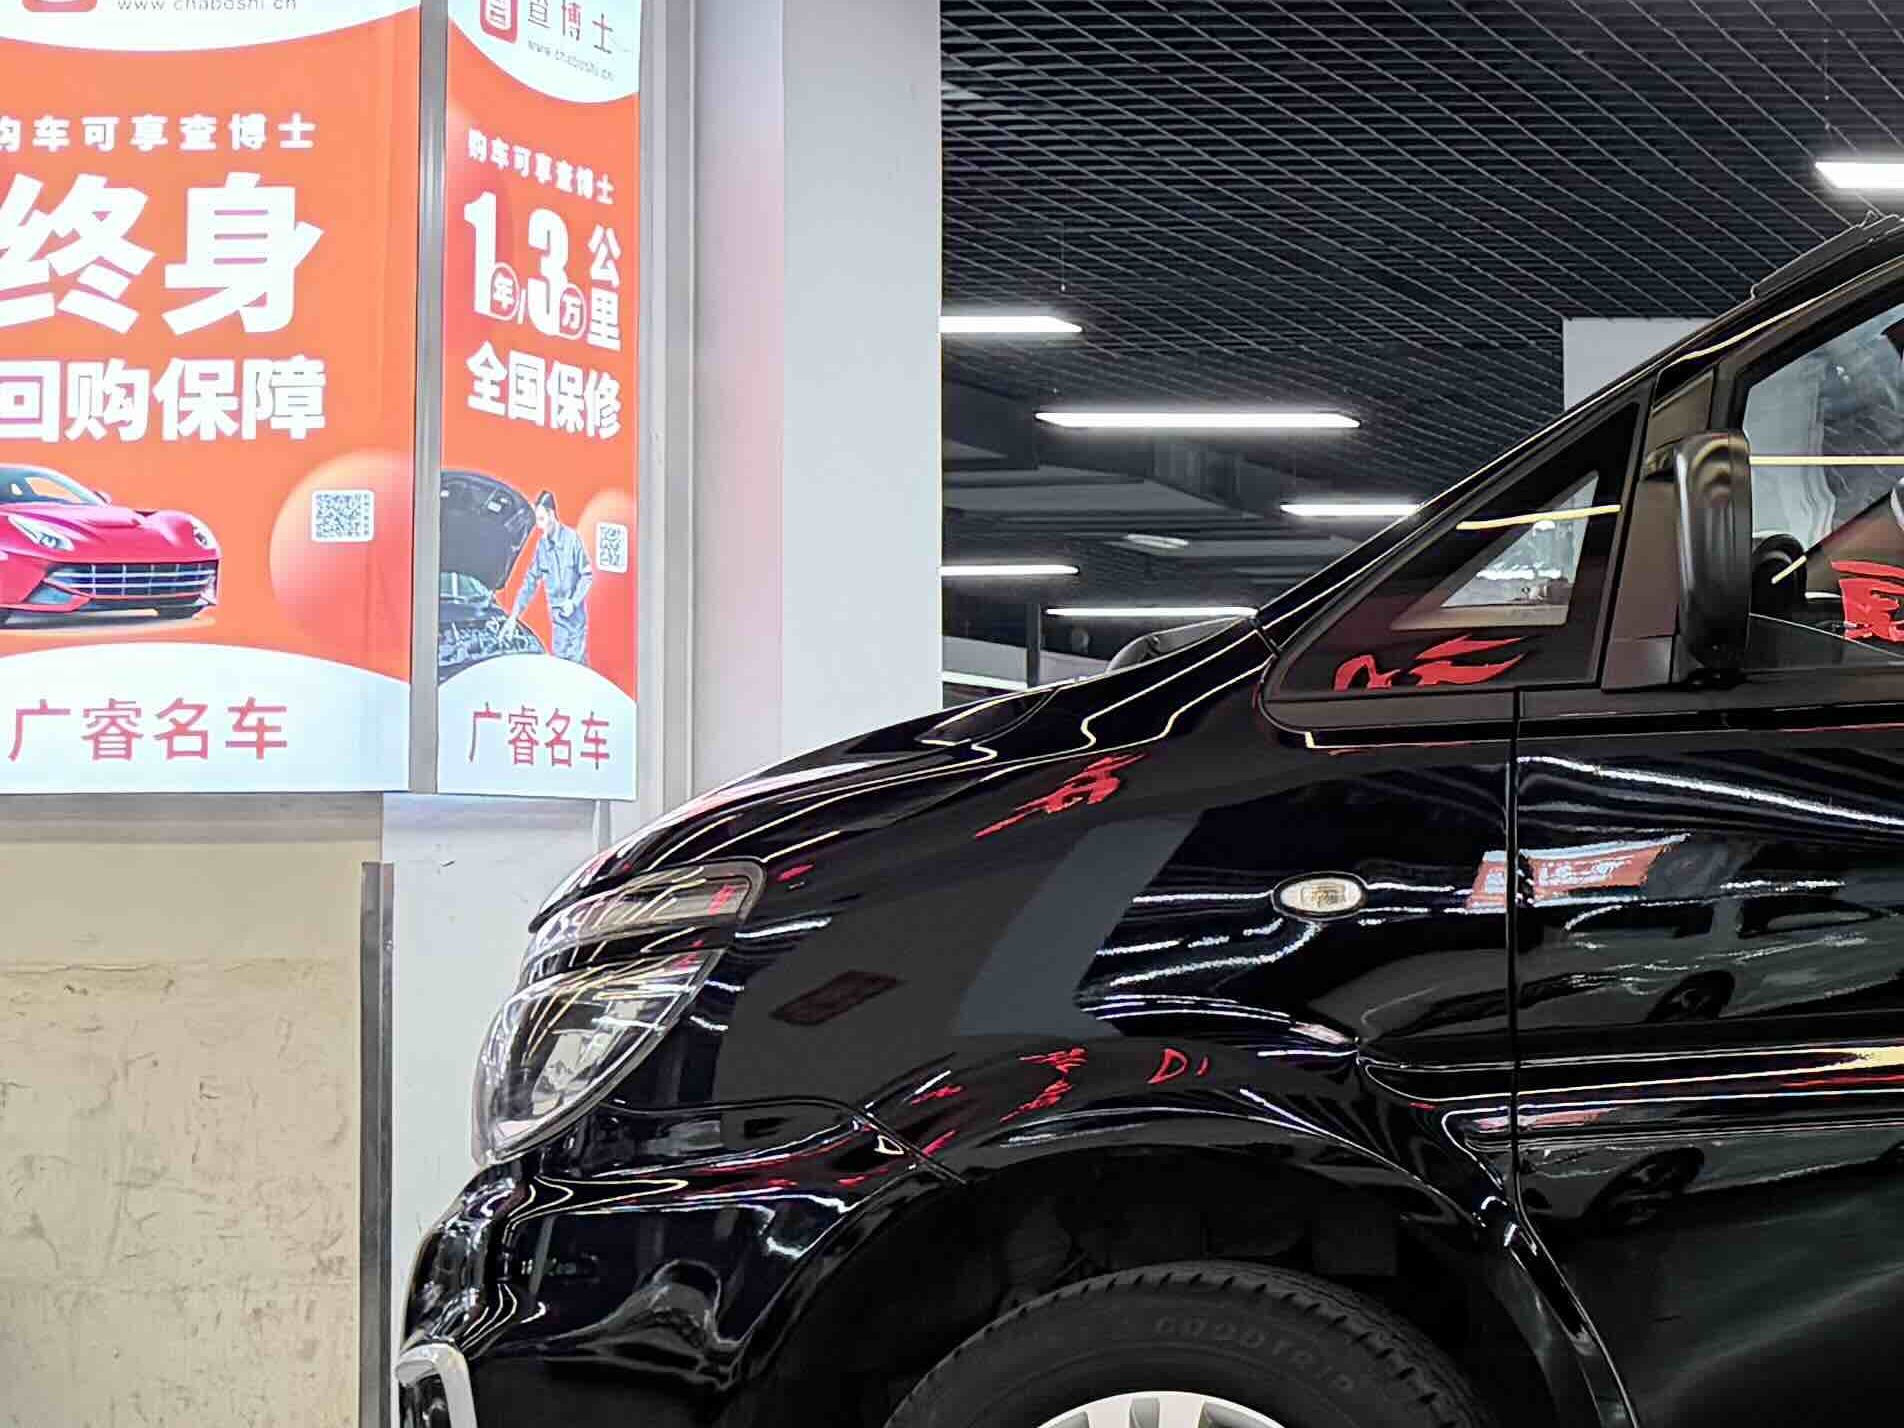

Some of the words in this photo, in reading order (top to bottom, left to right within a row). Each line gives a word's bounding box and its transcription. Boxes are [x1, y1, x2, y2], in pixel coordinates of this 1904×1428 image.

[467, 127, 614, 205] 购车可享查博士
[0, 172, 325, 336] 终身
[0, 354, 326, 443] 回购保障
[465, 339, 622, 440] 全国保修
[8, 697, 289, 762] 广睿名车
[467, 702, 612, 771] 广睿名车
